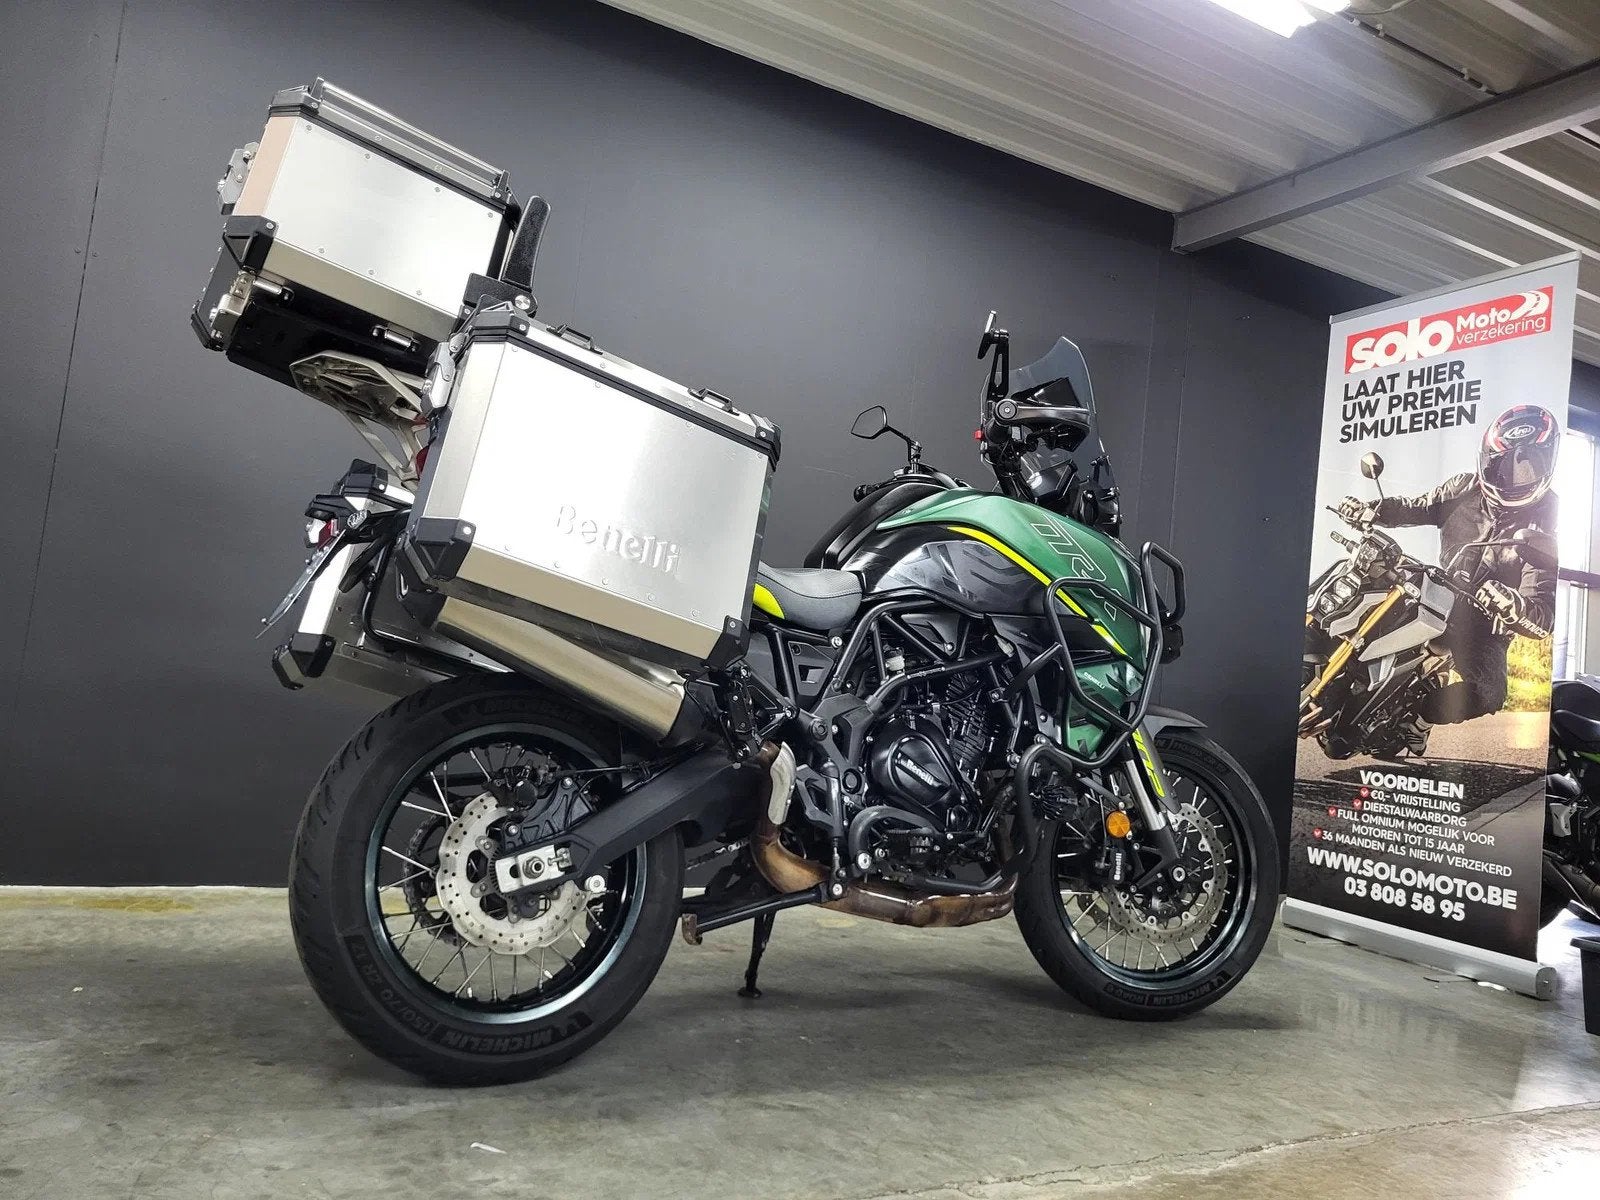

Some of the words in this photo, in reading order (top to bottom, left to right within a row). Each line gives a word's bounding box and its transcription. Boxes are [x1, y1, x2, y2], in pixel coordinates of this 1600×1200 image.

[1456, 308, 1511, 332] Moto
[1456, 316, 1546, 345] verzekering
[1349, 317, 1454, 373] solo
[1344, 373, 1400, 402] LAAT
[1407, 360, 1465, 391] HIER
[1342, 400, 1381, 422] UW
[1388, 380, 1482, 415] PREMIE
[1339, 404, 1477, 443] SIMULEREN
[556, 505, 680, 573] Benelli
[1360, 770, 1464, 799] VOORDELEN
[1393, 793, 1460, 813] VRIJSTELLING
[1337, 809, 1359, 821] FULL
[1361, 813, 1405, 830] OMNIUM
[1407, 821, 1460, 840] MOGELIJK
[1462, 830, 1495, 846] VOOR
[1363, 801, 1467, 827] DIEFSTALWAARBORG
[1321, 830, 1333, 841] 36
[1335, 833, 1385, 852] MAANDEN
[1387, 843, 1406, 856] ALS
[1409, 847, 1444, 864] NIEUW
[1446, 854, 1512, 877] VERZEKERD
[1352, 824, 1401, 842] MOTOREN
[1403, 833, 1423, 846] TOT
[1424, 837, 1435, 848] 15
[1436, 840, 1465, 854] JAAR
[1307, 846, 1517, 910] WWW.SOLOMOTO.BE
[1344, 876, 1367, 898] 03
[1370, 882, 1406, 907] 808
[1411, 892, 1435, 913] 58
[1440, 900, 1465, 921] 95
[444, 1029, 552, 1053] MICHELIN
